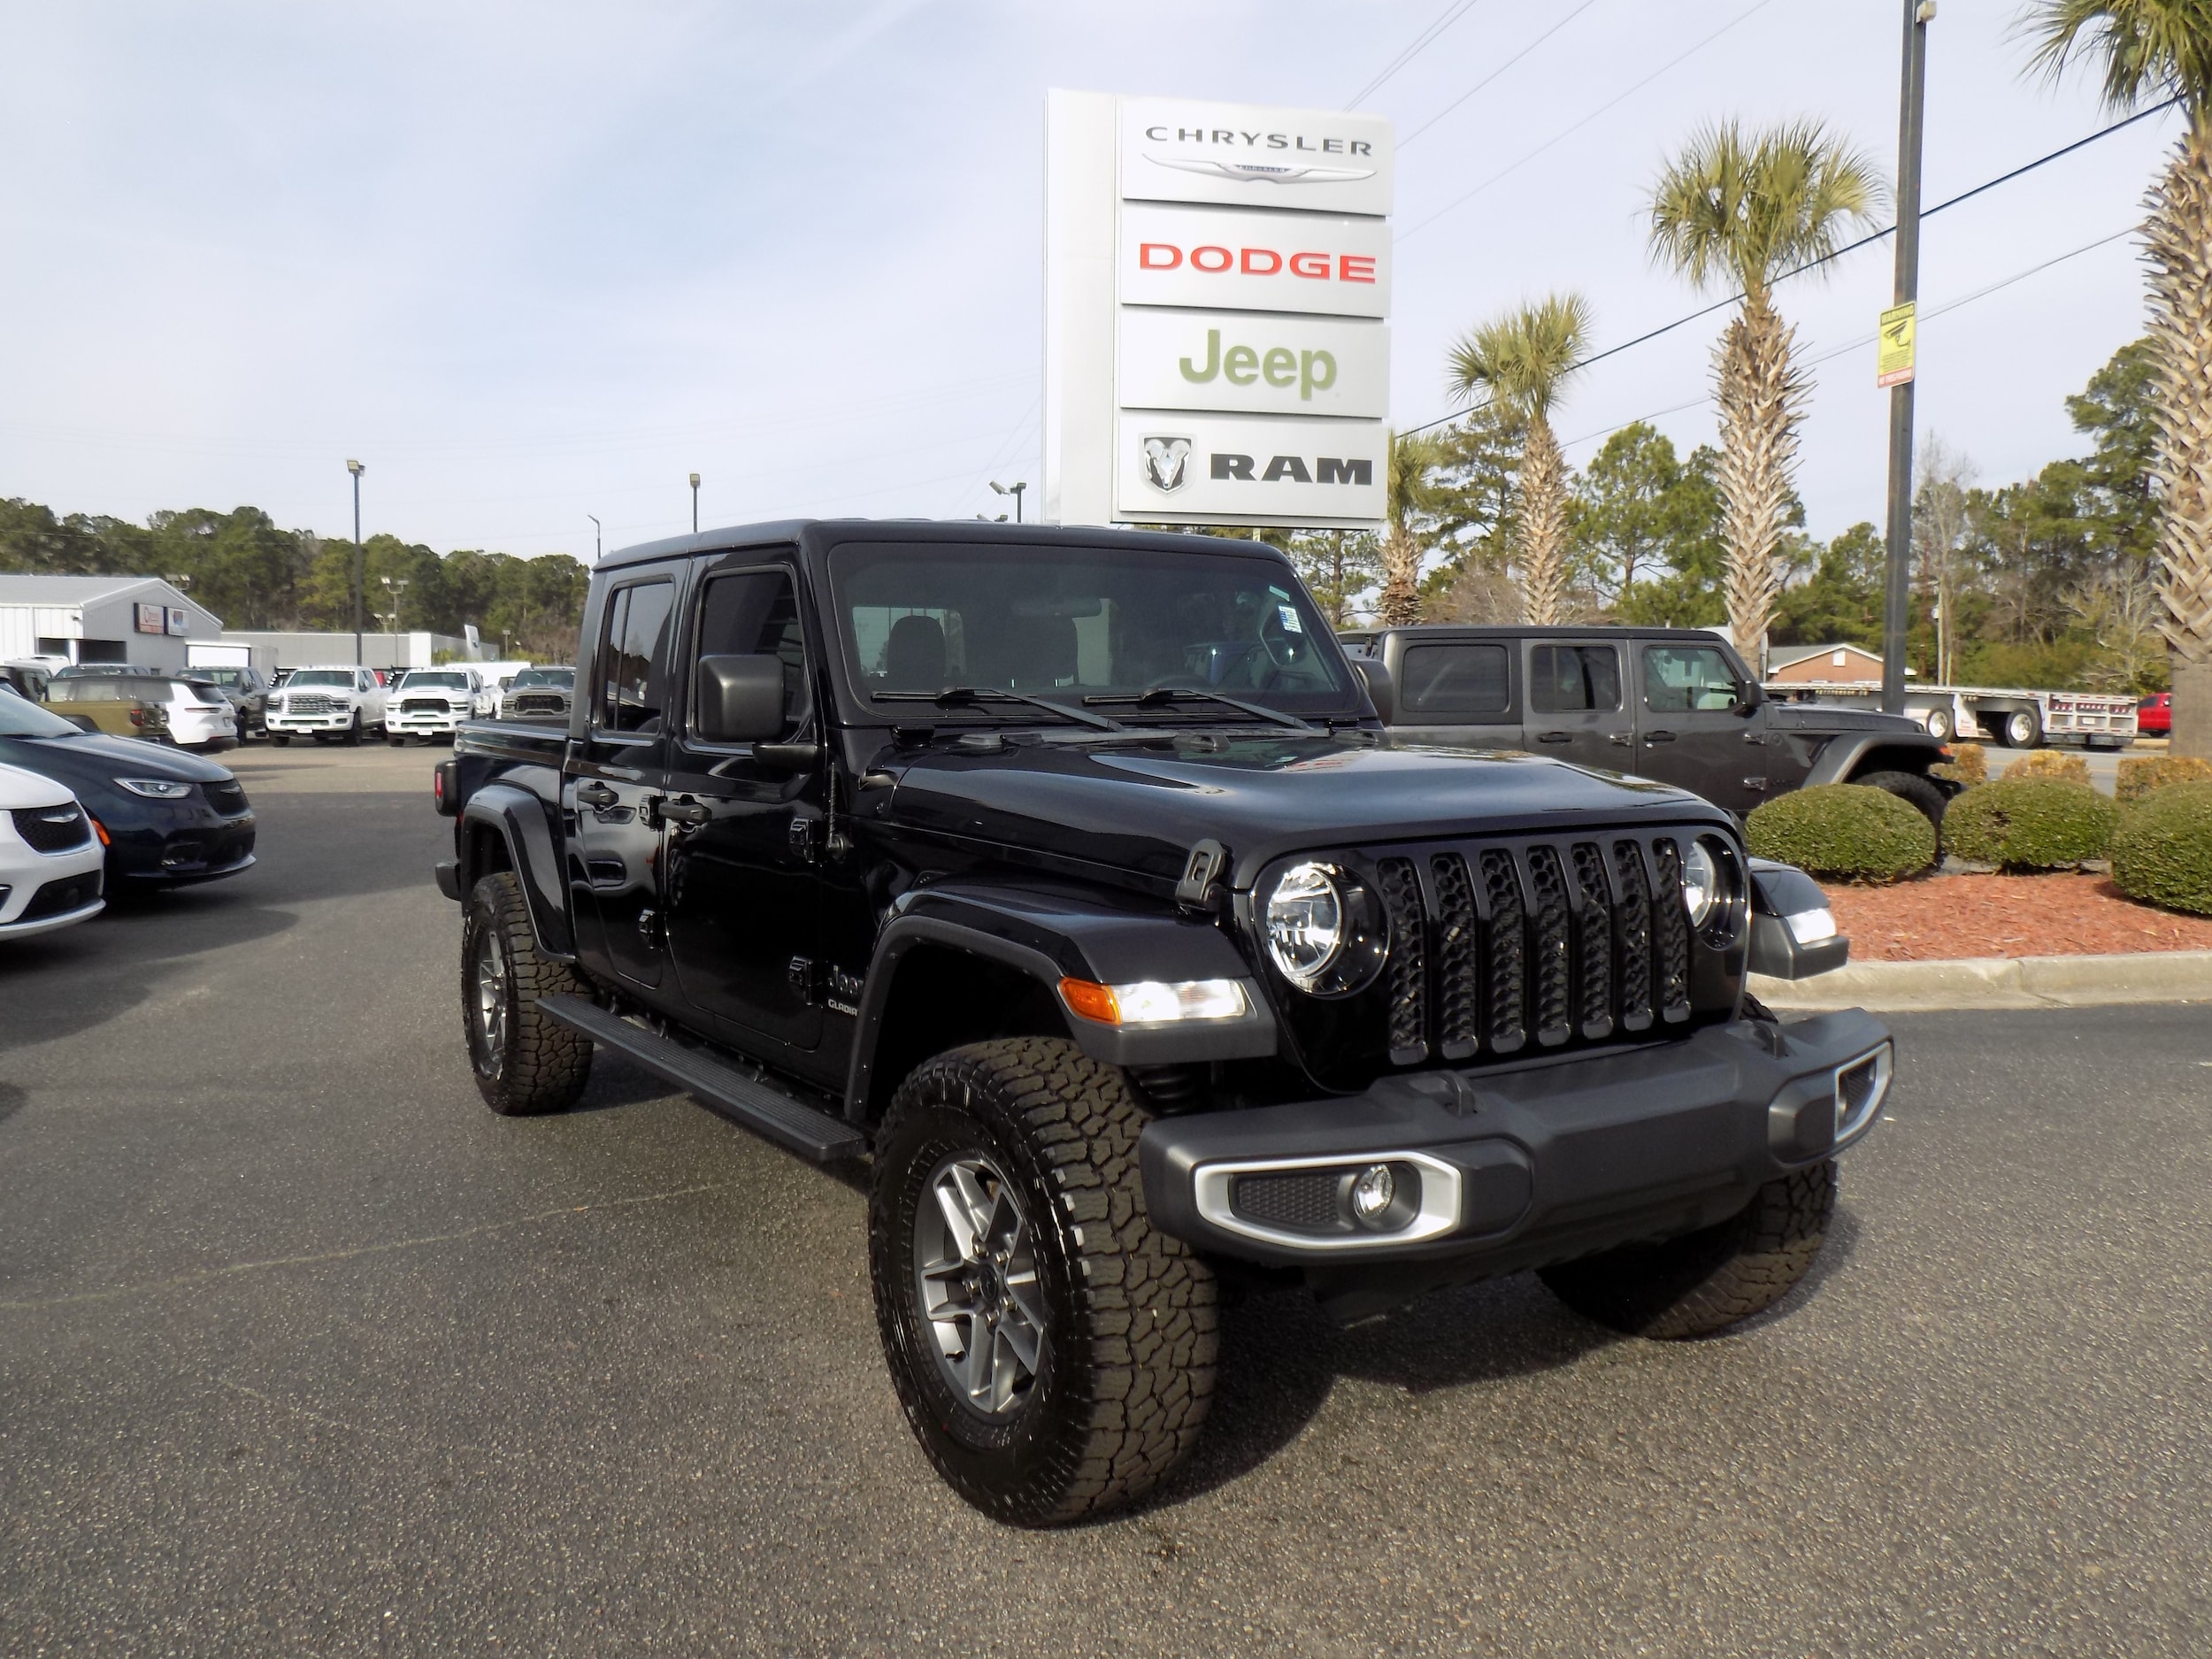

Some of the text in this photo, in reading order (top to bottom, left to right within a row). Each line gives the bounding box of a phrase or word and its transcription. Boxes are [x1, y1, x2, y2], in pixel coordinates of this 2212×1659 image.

[1146, 126, 1373, 157] CHRYSLER
[1140, 242, 1376, 284] DODGE
[1179, 329, 1338, 401] Jeep
[1210, 452, 1373, 486] RAM
[826, 964, 864, 995] Jee
[827, 998, 859, 1018] GLADIA
